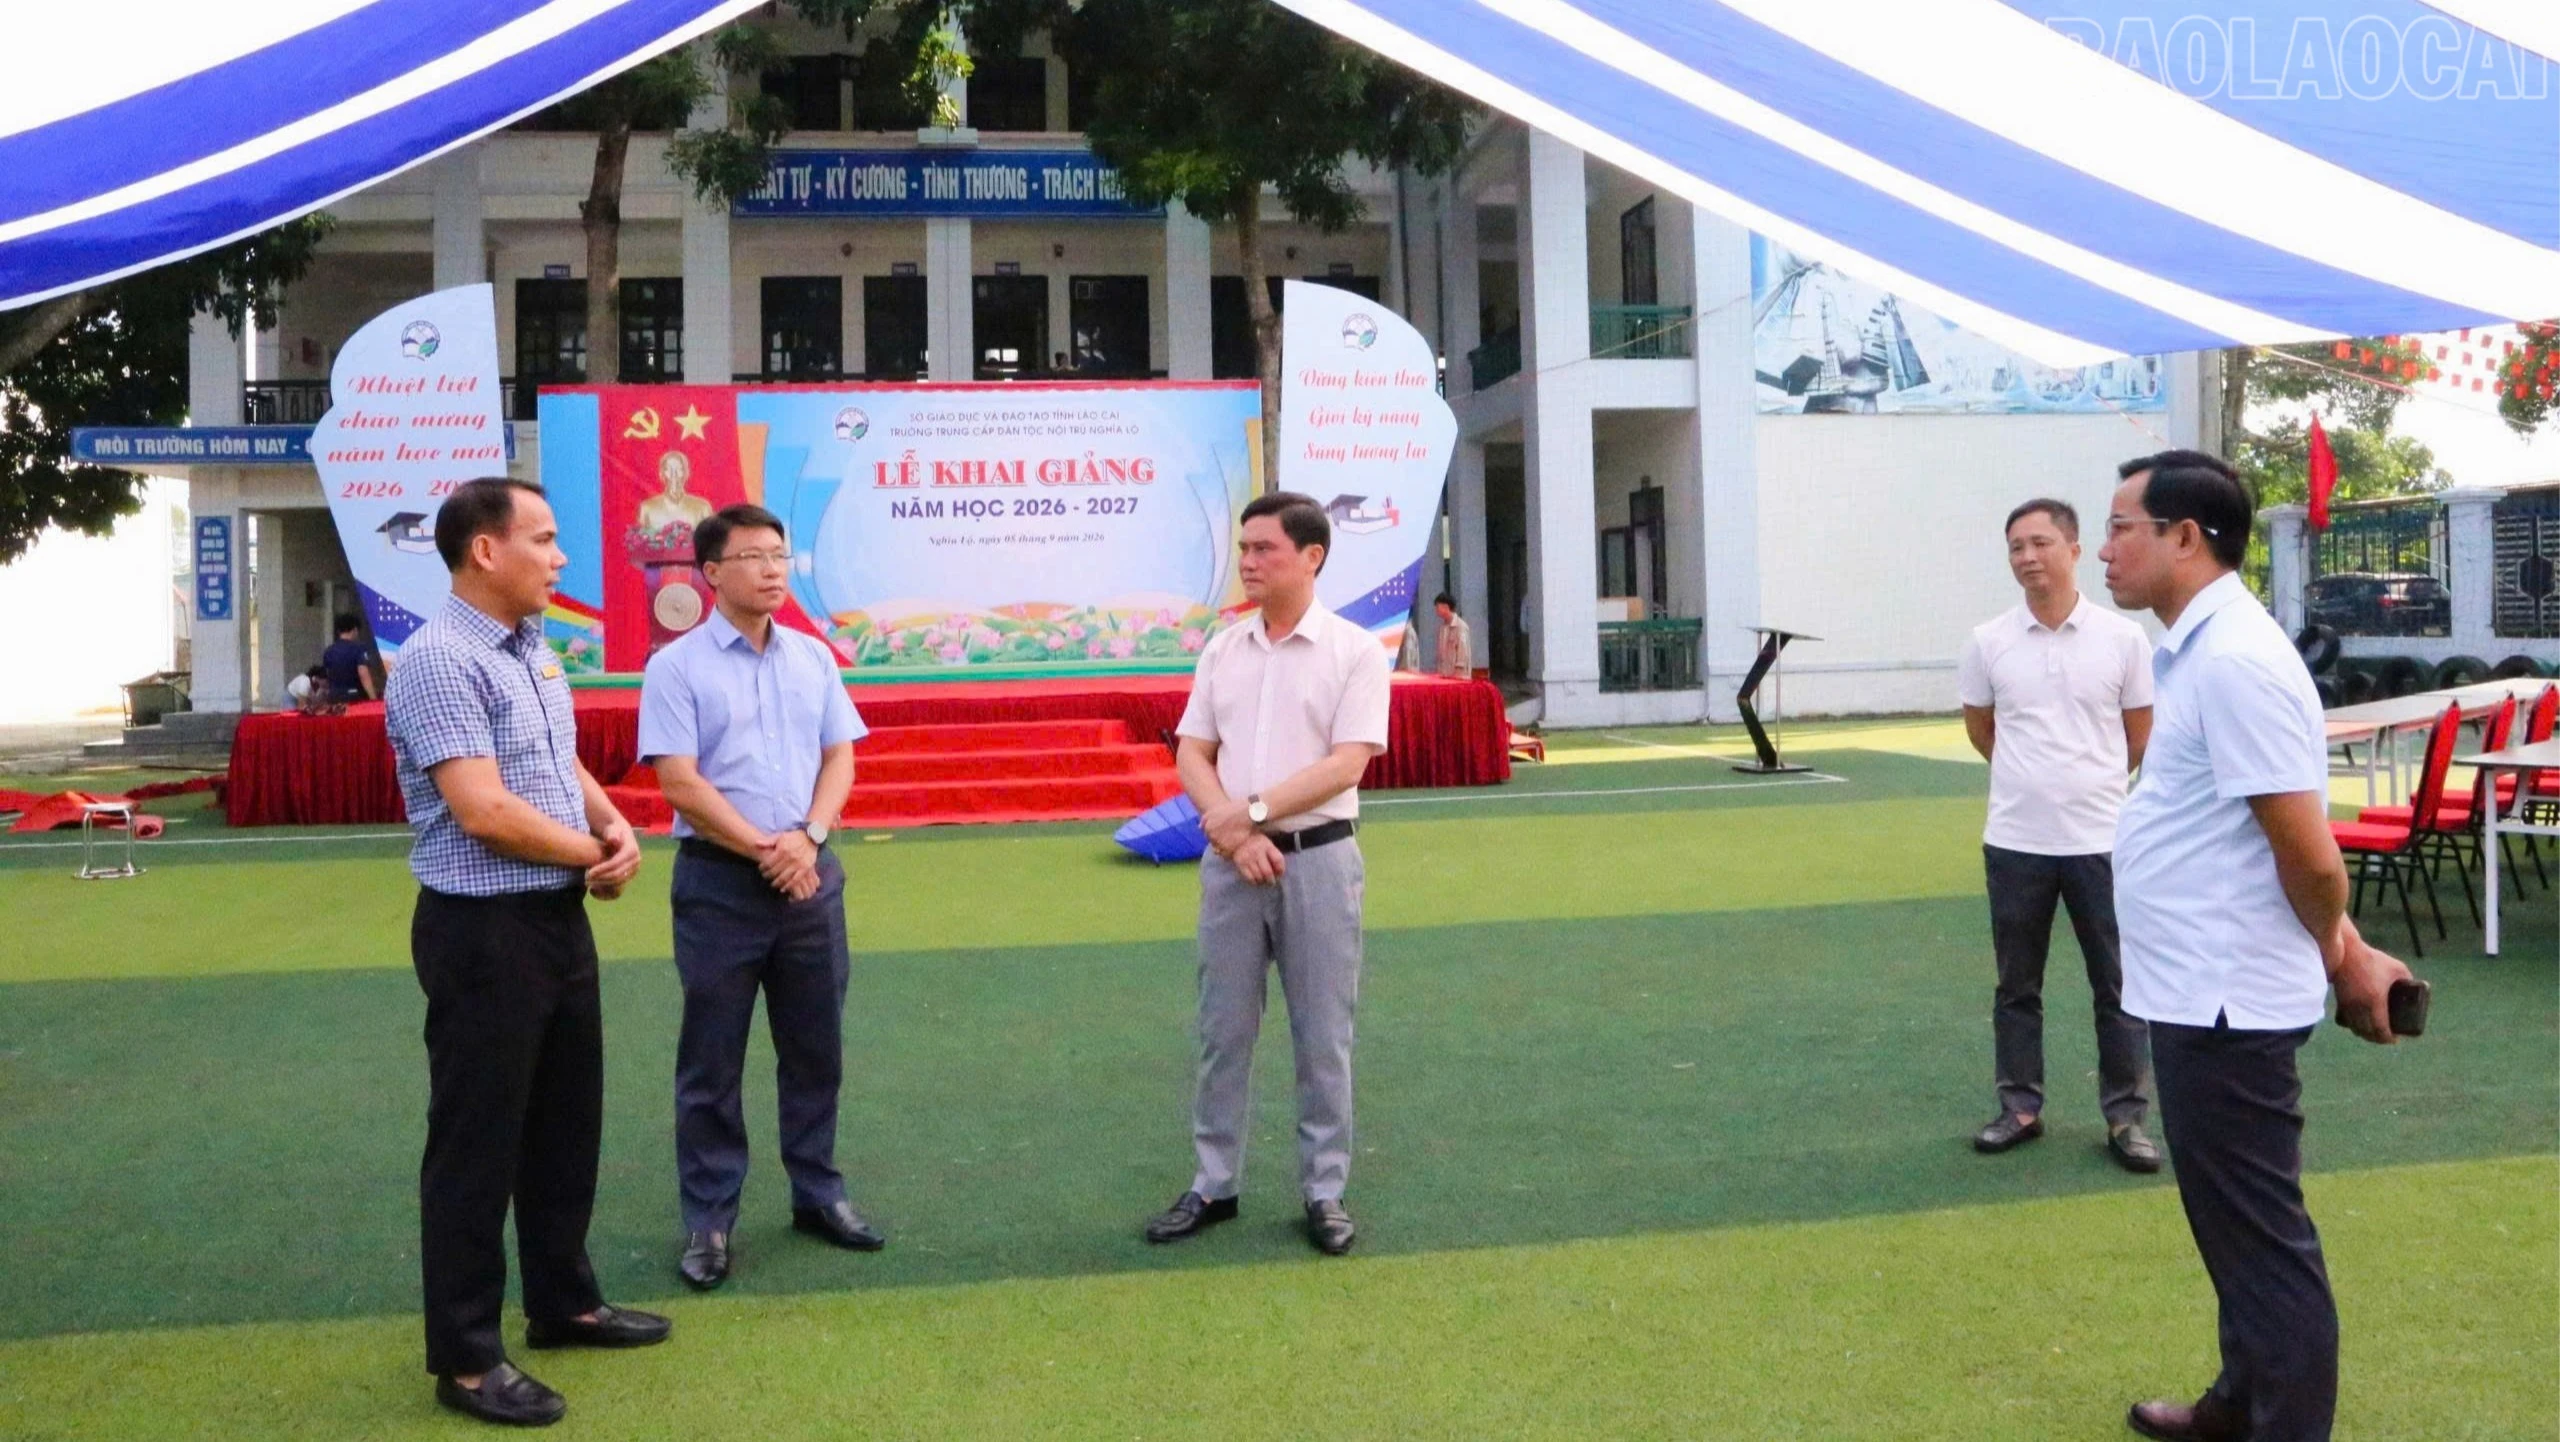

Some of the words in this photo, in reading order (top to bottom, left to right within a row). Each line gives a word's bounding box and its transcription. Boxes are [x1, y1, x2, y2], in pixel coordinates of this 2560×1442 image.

[789, 163, 812, 208] TỰ
[825, 156, 847, 200] KỶ
[851, 164, 907, 200] CƯƠNG
[922, 160, 958, 200] TÌNH
[964, 164, 1027, 200] THƯƠNG
[1042, 160, 1095, 200] TRÁCH
[436, 373, 479, 397] liệt
[339, 410, 399, 429] chào
[411, 411, 487, 430] mừng
[1101, 410, 1120, 420] CAI
[936, 426, 970, 436] TRUNG
[94, 435, 130, 454] MÔI
[134, 434, 204, 455] TRƯỜNG
[209, 435, 249, 454] HÔM
[255, 438, 288, 454] NAY
[327, 446, 384, 463] năm
[395, 441, 440, 466] học
[872, 449, 922, 489] LỄ
[930, 458, 1028, 488] KHAI
[1036, 450, 1158, 487] GIẢNG
[340, 481, 404, 499] 2026
[891, 496, 944, 519] NĂM
[952, 499, 1005, 523] HỌC
[1013, 498, 1067, 517] 2026
[1087, 497, 1140, 516] 2027
